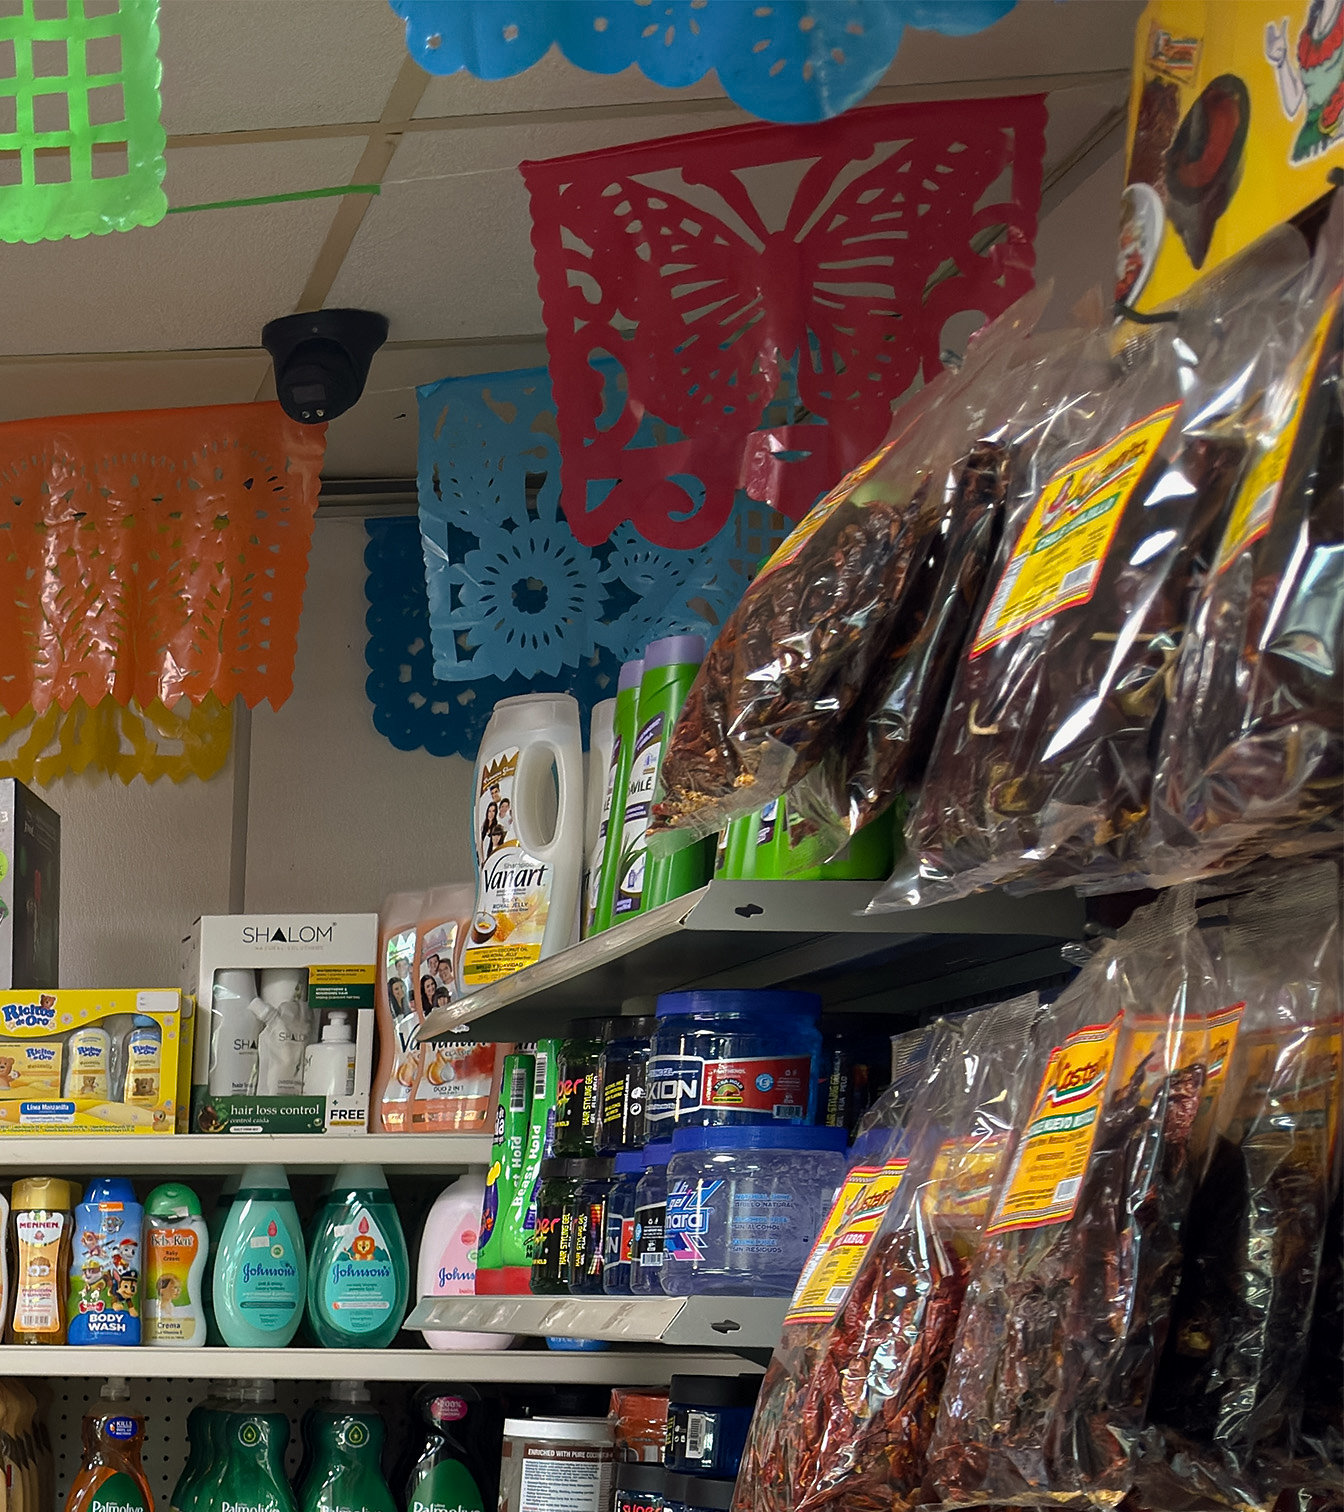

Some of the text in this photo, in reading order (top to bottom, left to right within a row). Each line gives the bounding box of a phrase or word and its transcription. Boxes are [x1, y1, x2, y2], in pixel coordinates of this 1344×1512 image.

[483, 864, 548, 894] Vanart
[242, 926, 333, 943] SHALOM
[2, 1005, 56, 1021] Ricitos
[25, 1016, 49, 1027] Oro
[230, 1105, 319, 1115] hair loss control
[330, 1110, 365, 1120] FREE
[513, 1125, 542, 1208] Beast Hold
[332, 1265, 391, 1284] Johnson's
[89, 1314, 123, 1324] BODY
[88, 1323, 126, 1333] WASH
[528, 1449, 571, 1458] ENRICHED WITH
